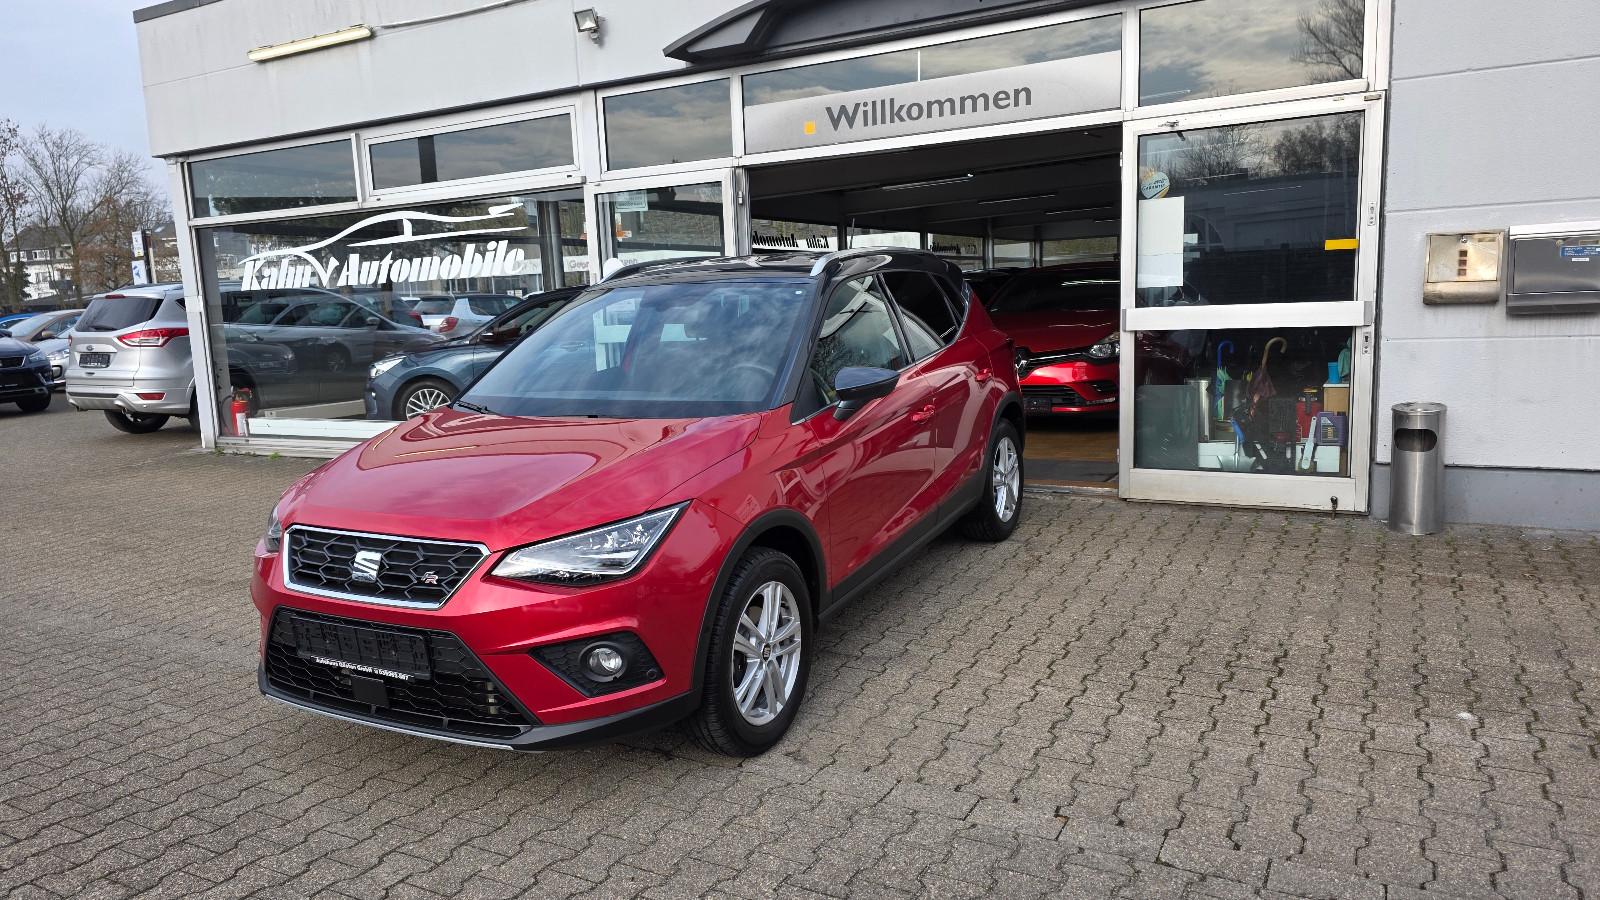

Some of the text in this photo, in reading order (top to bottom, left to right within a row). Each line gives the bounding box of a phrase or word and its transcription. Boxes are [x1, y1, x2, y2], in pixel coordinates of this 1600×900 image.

[825, 86, 1033, 132] Willkommen
[240, 240, 525, 291] Kahn Automobile
